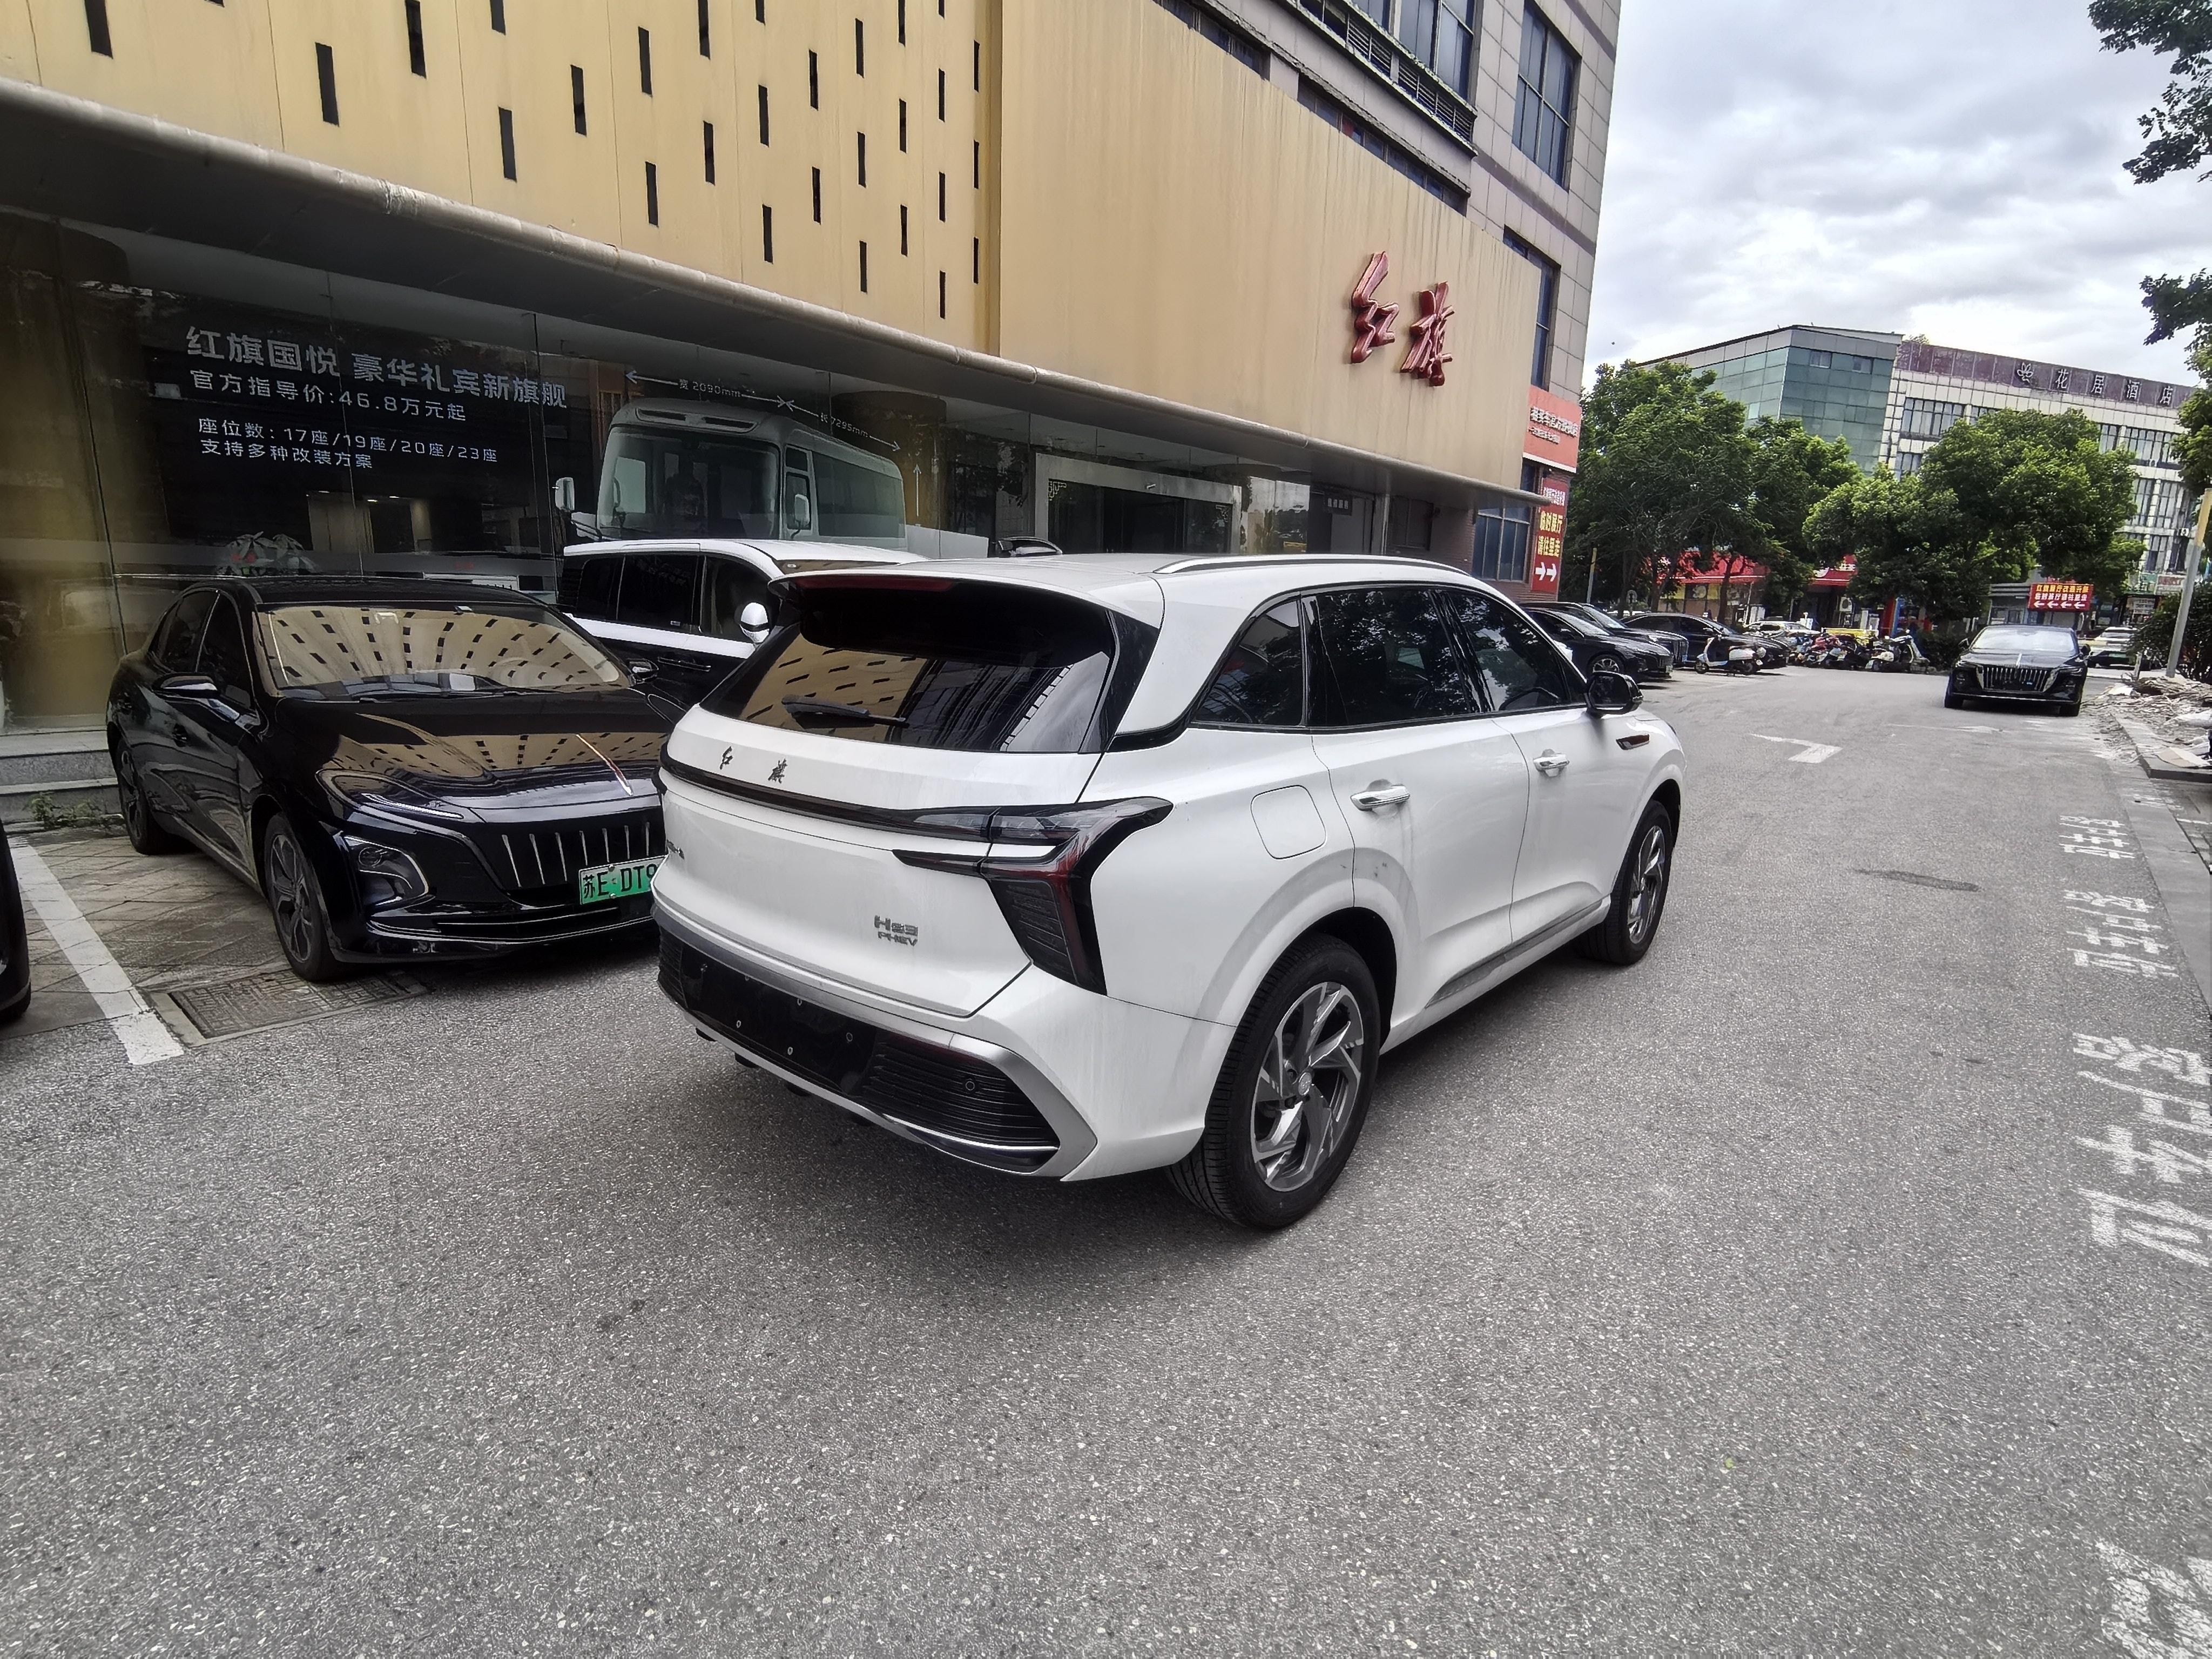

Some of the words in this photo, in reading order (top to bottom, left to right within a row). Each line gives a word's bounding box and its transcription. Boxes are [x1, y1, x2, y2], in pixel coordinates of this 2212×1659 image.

[186, 325, 340, 377] 红旗国悦
[351, 352, 567, 409] 豪华礼宾新旗舰
[200, 438, 373, 469] 支持多种改装方案
[878, 932, 918, 946] PHEV
